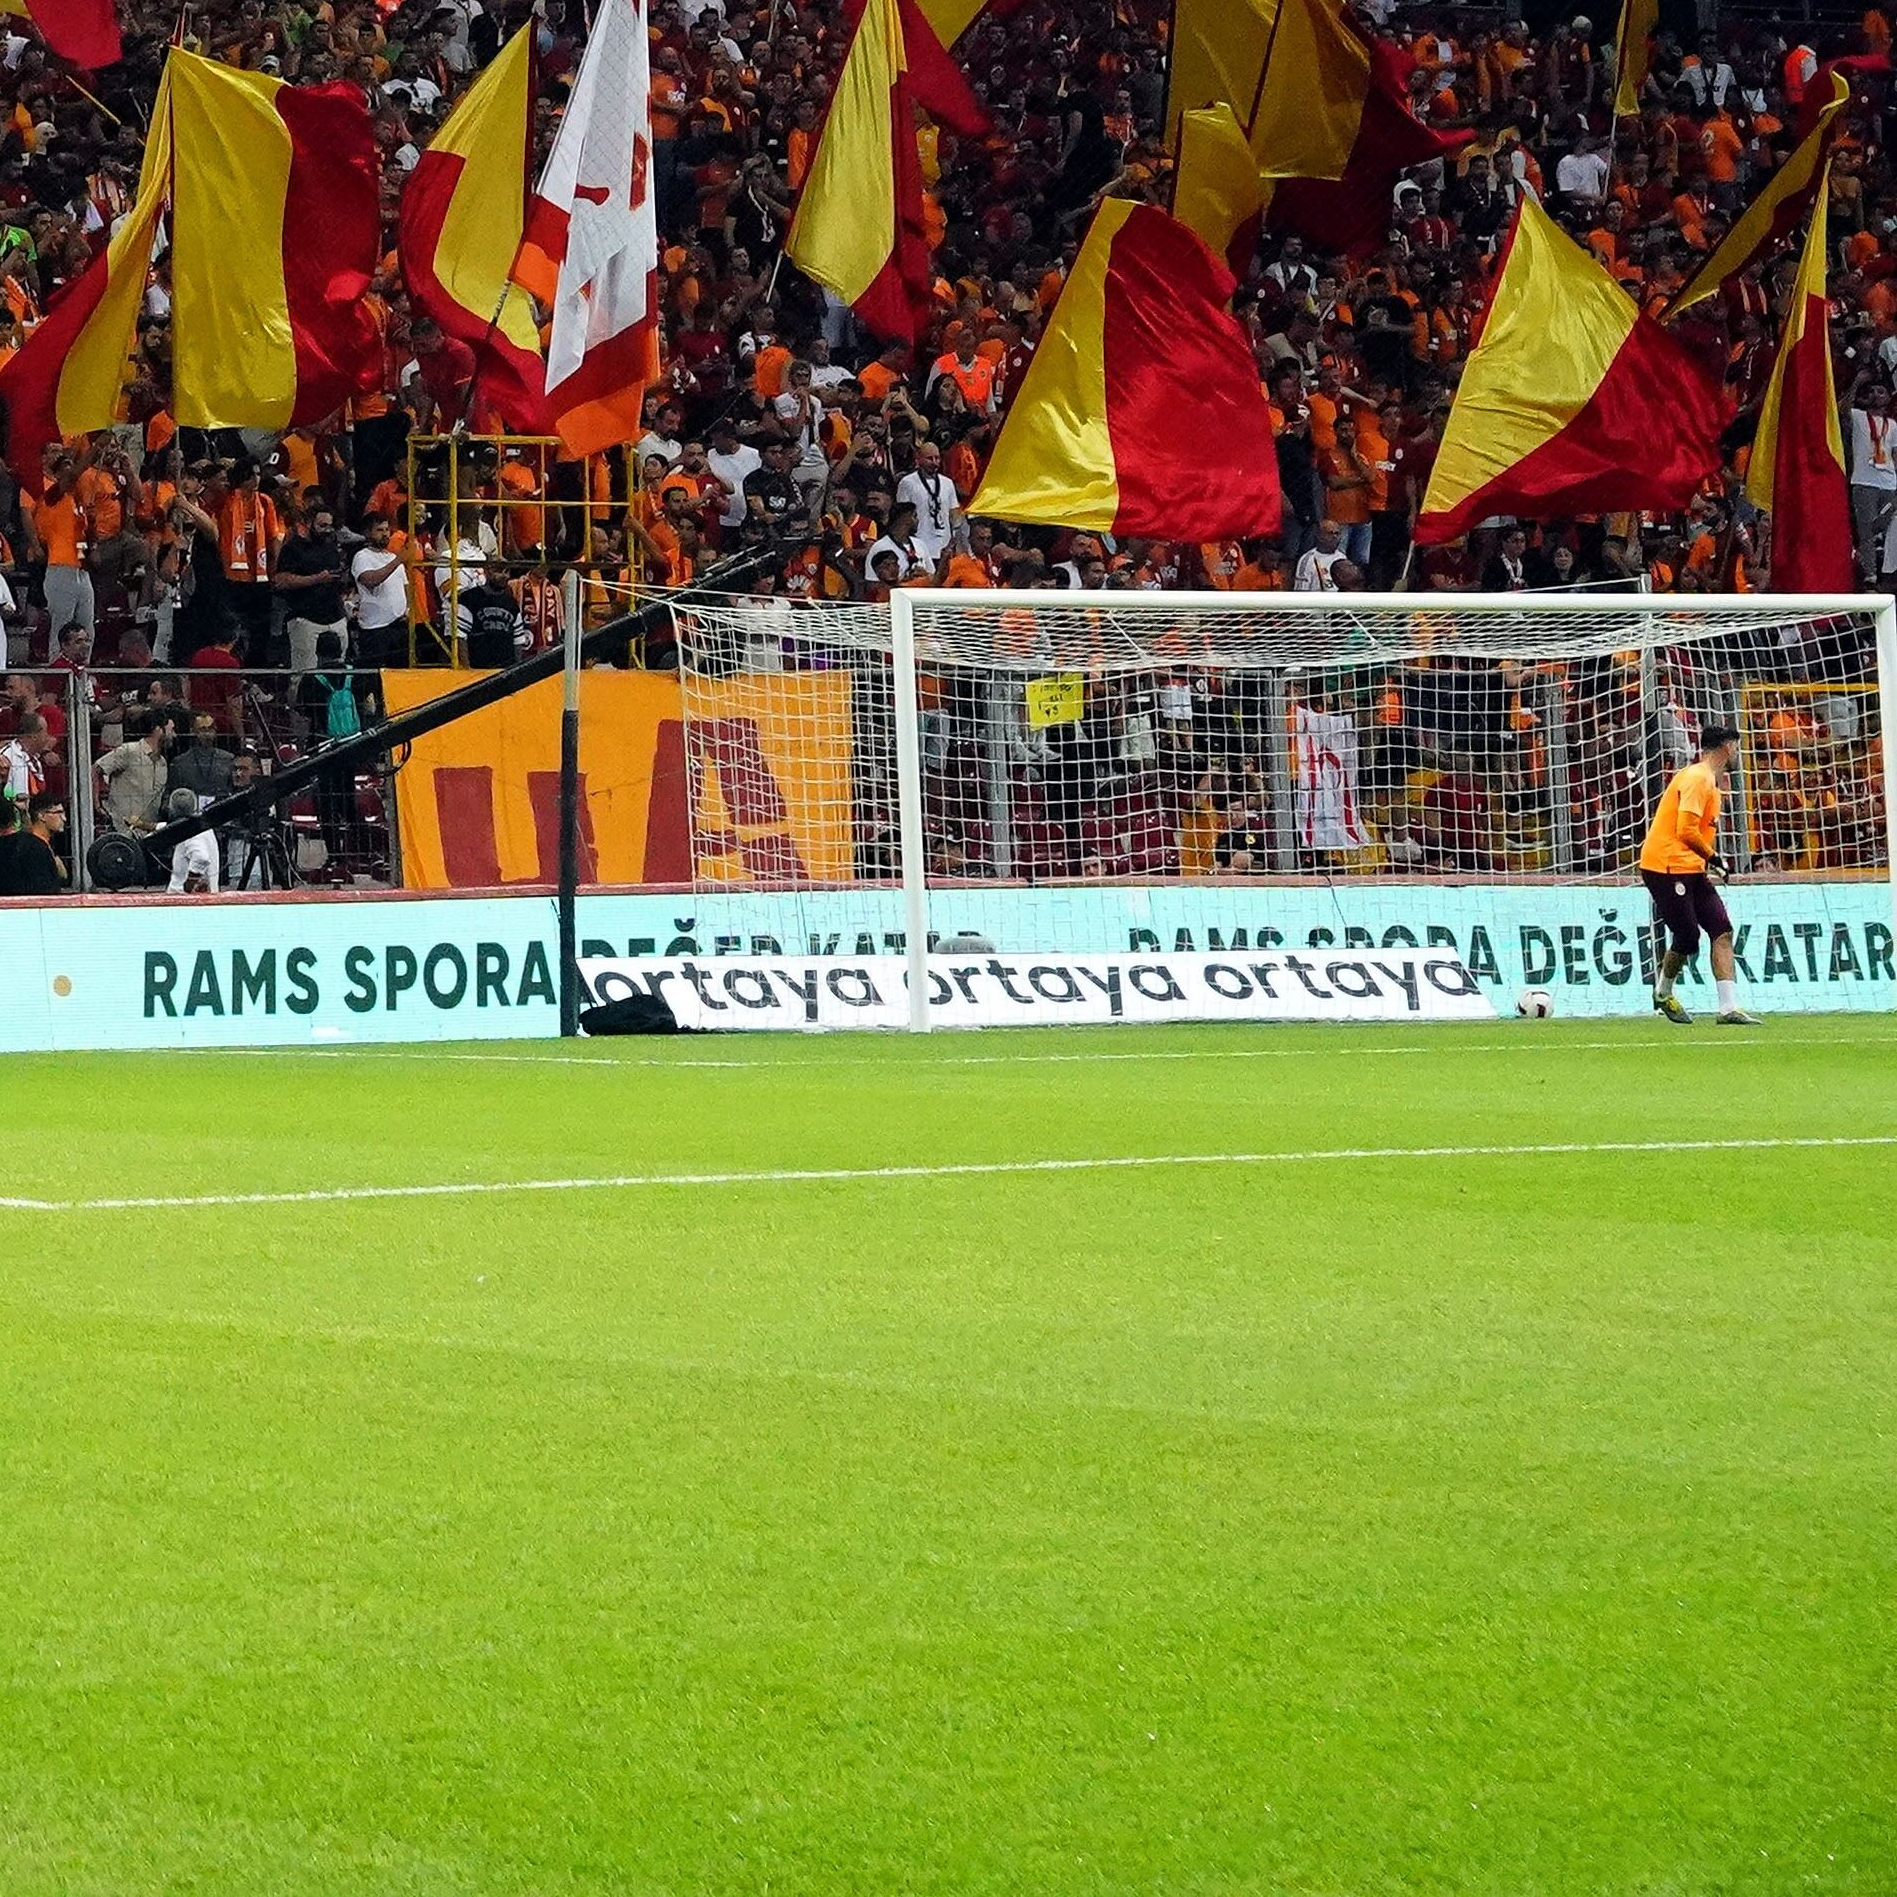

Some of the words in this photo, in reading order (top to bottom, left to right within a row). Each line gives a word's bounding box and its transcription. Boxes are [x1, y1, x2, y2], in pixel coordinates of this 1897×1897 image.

[143, 946, 320, 1018] RAMS
[343, 941, 557, 1013] SPORA
[1203, 953, 1483, 1011] ortaya
